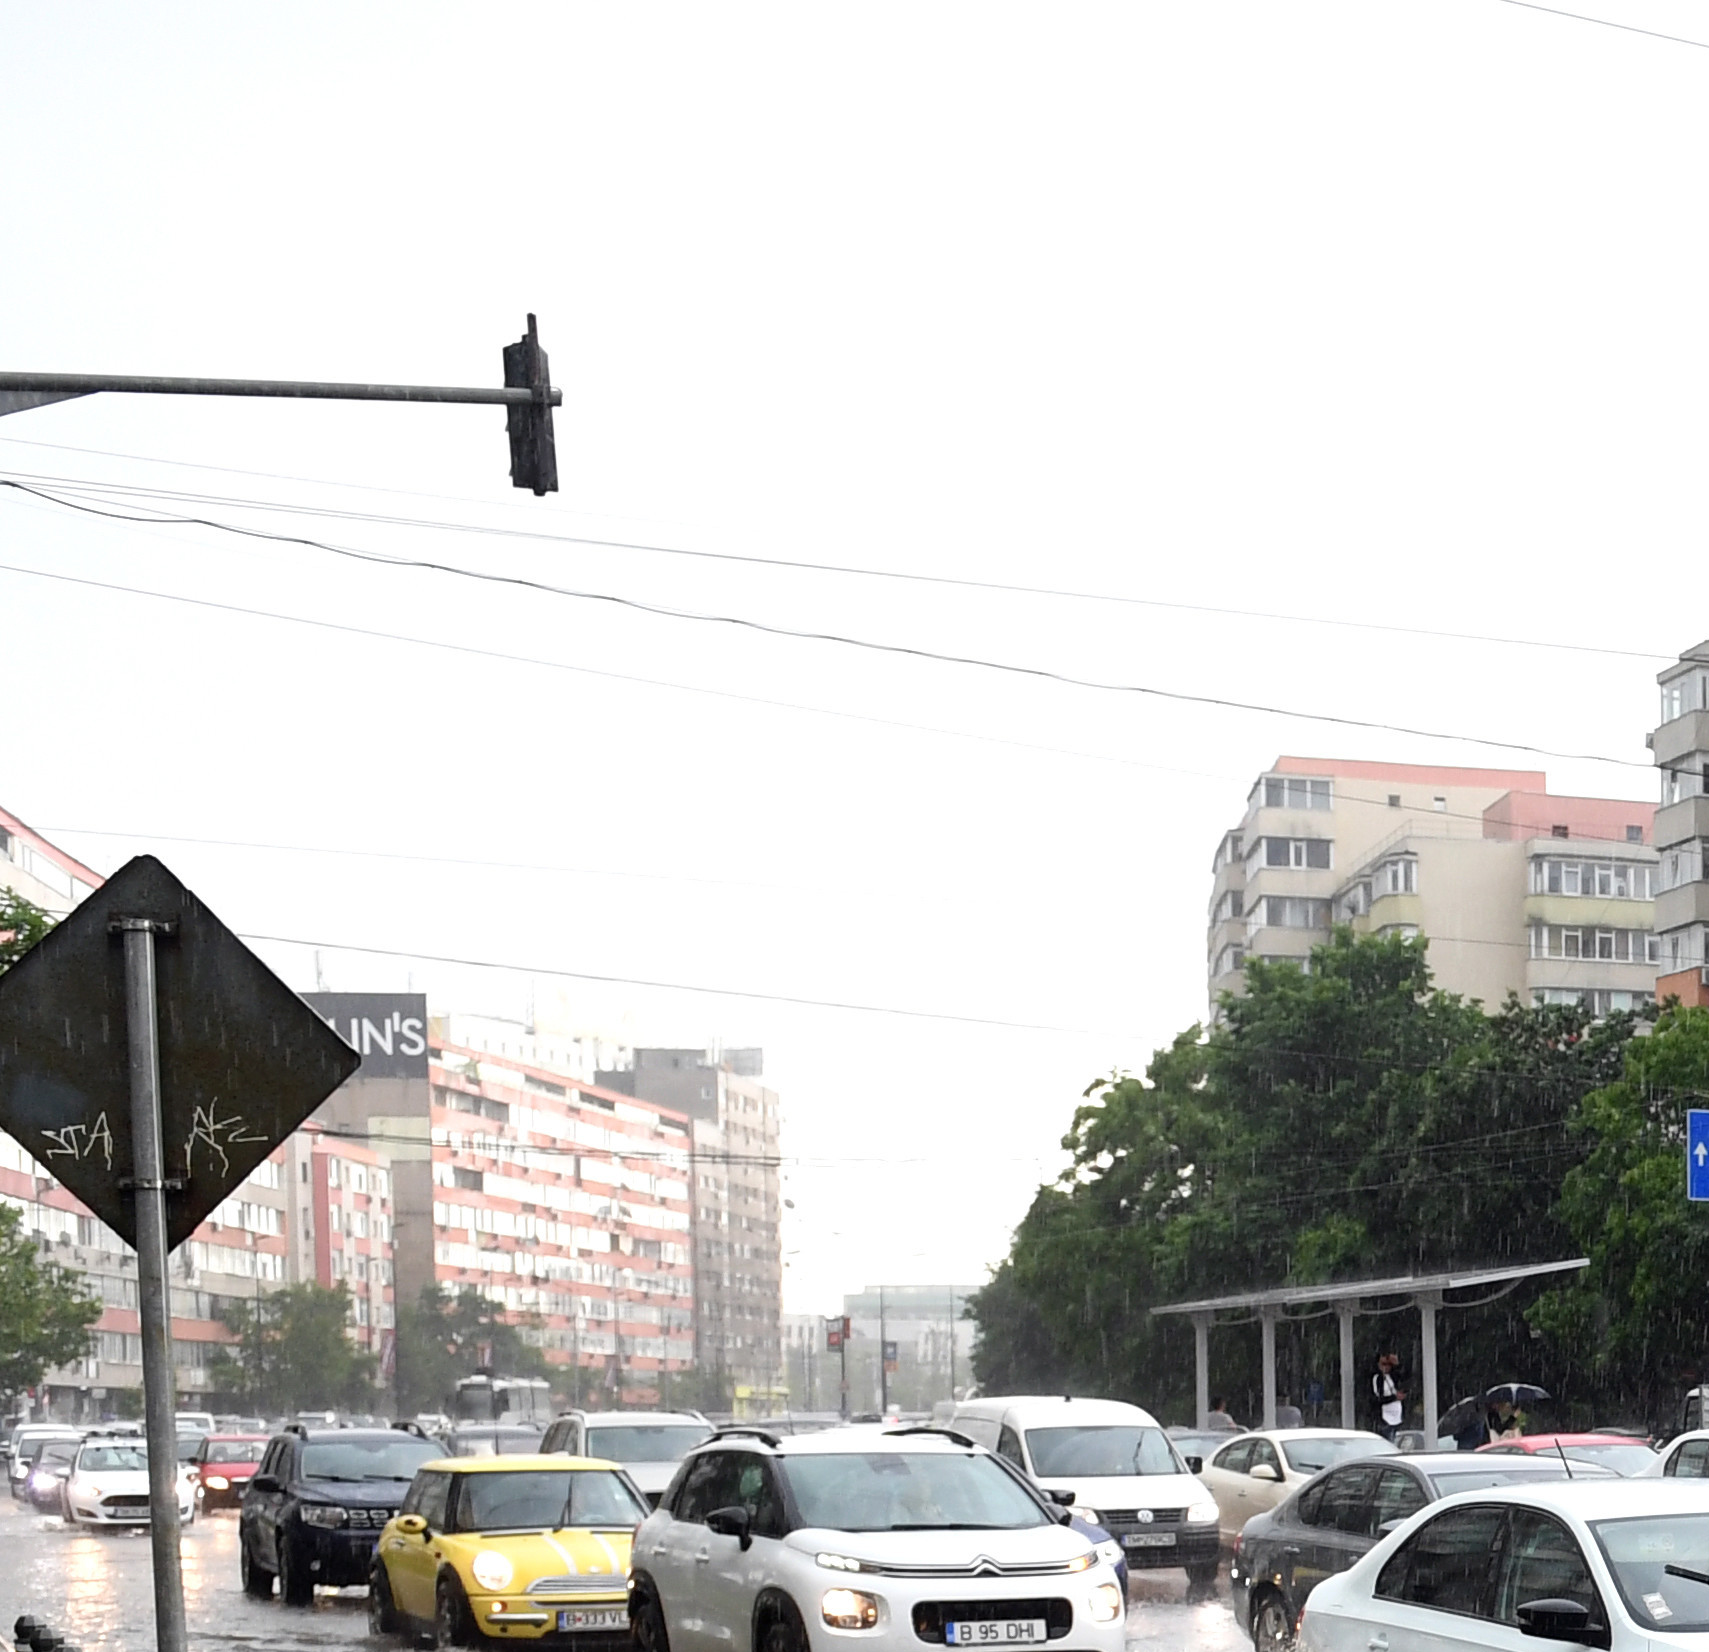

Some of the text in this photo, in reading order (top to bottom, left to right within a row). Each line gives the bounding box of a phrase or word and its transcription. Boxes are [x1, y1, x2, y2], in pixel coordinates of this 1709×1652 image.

[960, 1622, 1035, 1641] B 95 DHI
